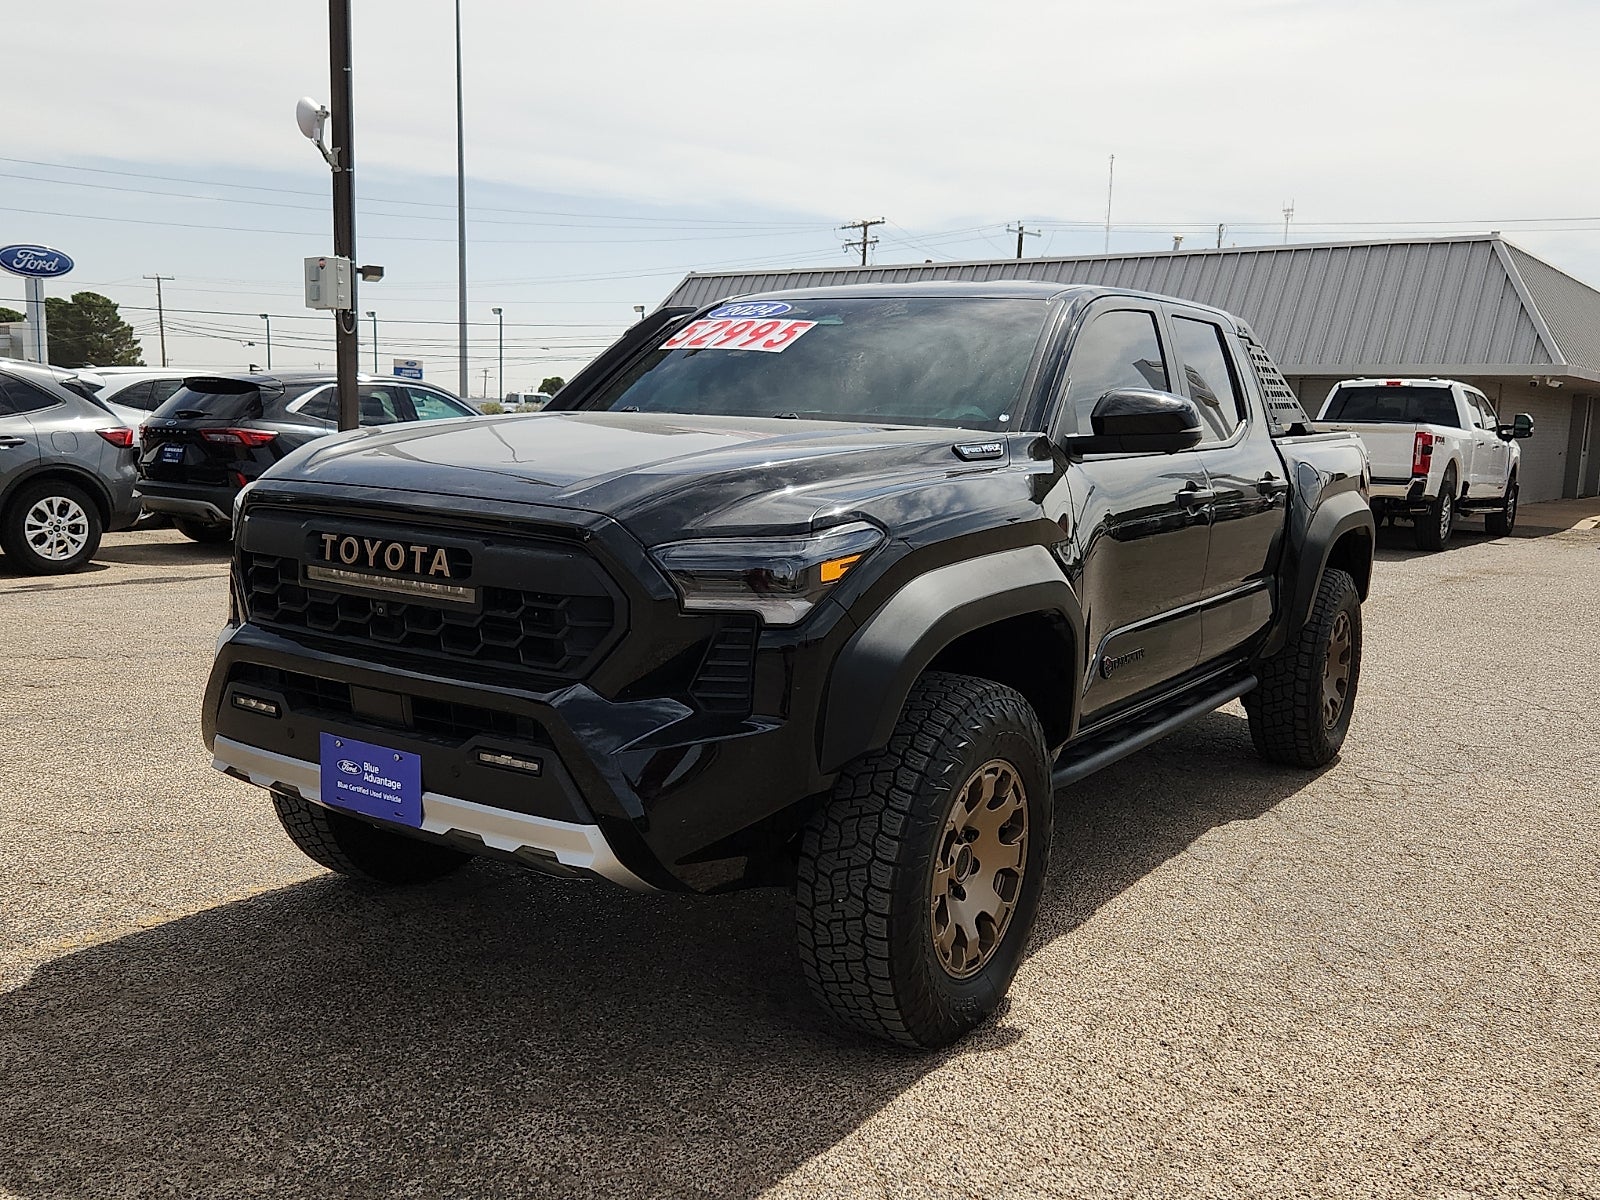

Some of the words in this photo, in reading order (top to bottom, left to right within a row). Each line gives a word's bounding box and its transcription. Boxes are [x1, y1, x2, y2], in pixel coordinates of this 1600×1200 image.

[13, 249, 59, 271] Ford
[716, 302, 779, 317] 2024
[666, 320, 814, 348] 52995
[321, 533, 451, 577] TOYOTA
[341, 761, 358, 773] Ford
[363, 762, 379, 774] Blue
[363, 772, 402, 790] Advantage
[337, 780, 348, 790] Blue
[348, 783, 369, 795] Certified
[369, 790, 382, 799] Used
[383, 793, 402, 804] Vehicle
